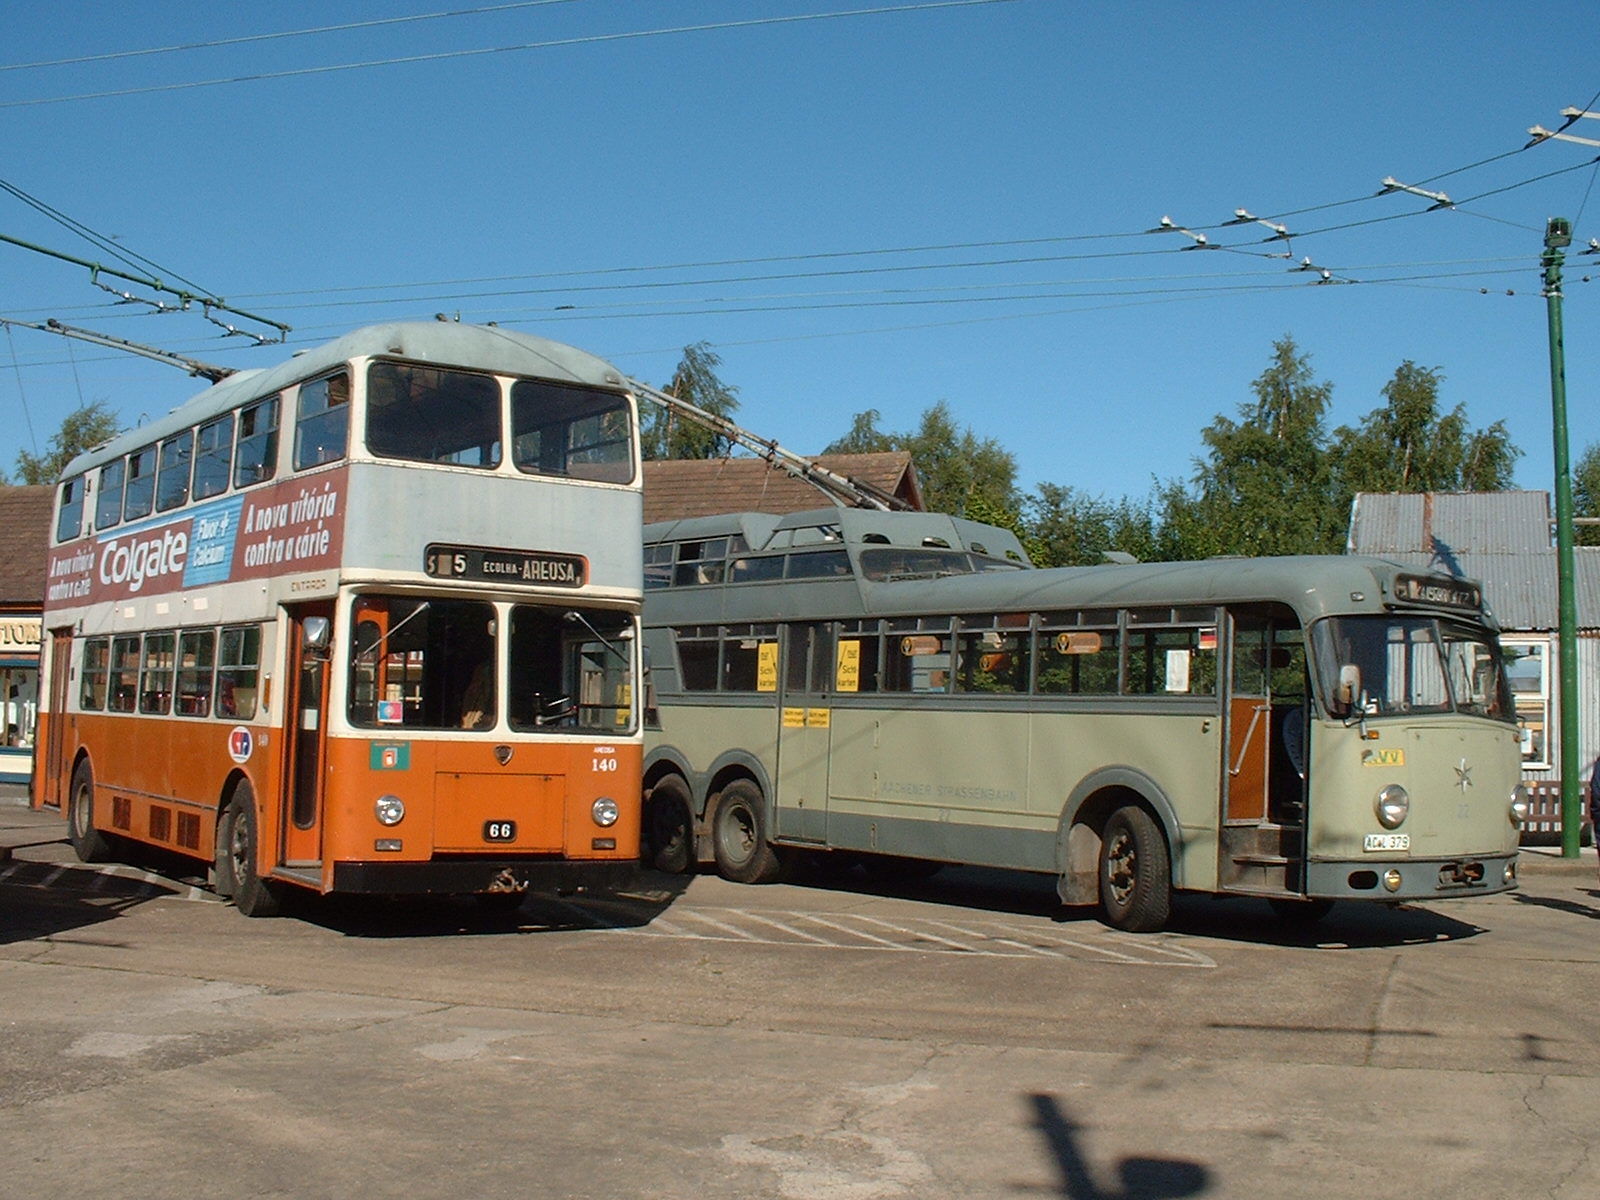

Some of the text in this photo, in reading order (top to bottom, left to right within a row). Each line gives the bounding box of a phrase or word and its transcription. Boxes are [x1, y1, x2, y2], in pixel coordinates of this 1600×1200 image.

[244, 482, 337, 534] A nova vitória
[244, 520, 330, 567] contra a cárie
[100, 530, 187, 592] Colgate
[454, 553, 467, 573] 5
[0, 622, 41, 645] TON
[592, 758, 618, 772] 140
[489, 823, 511, 838] 66
